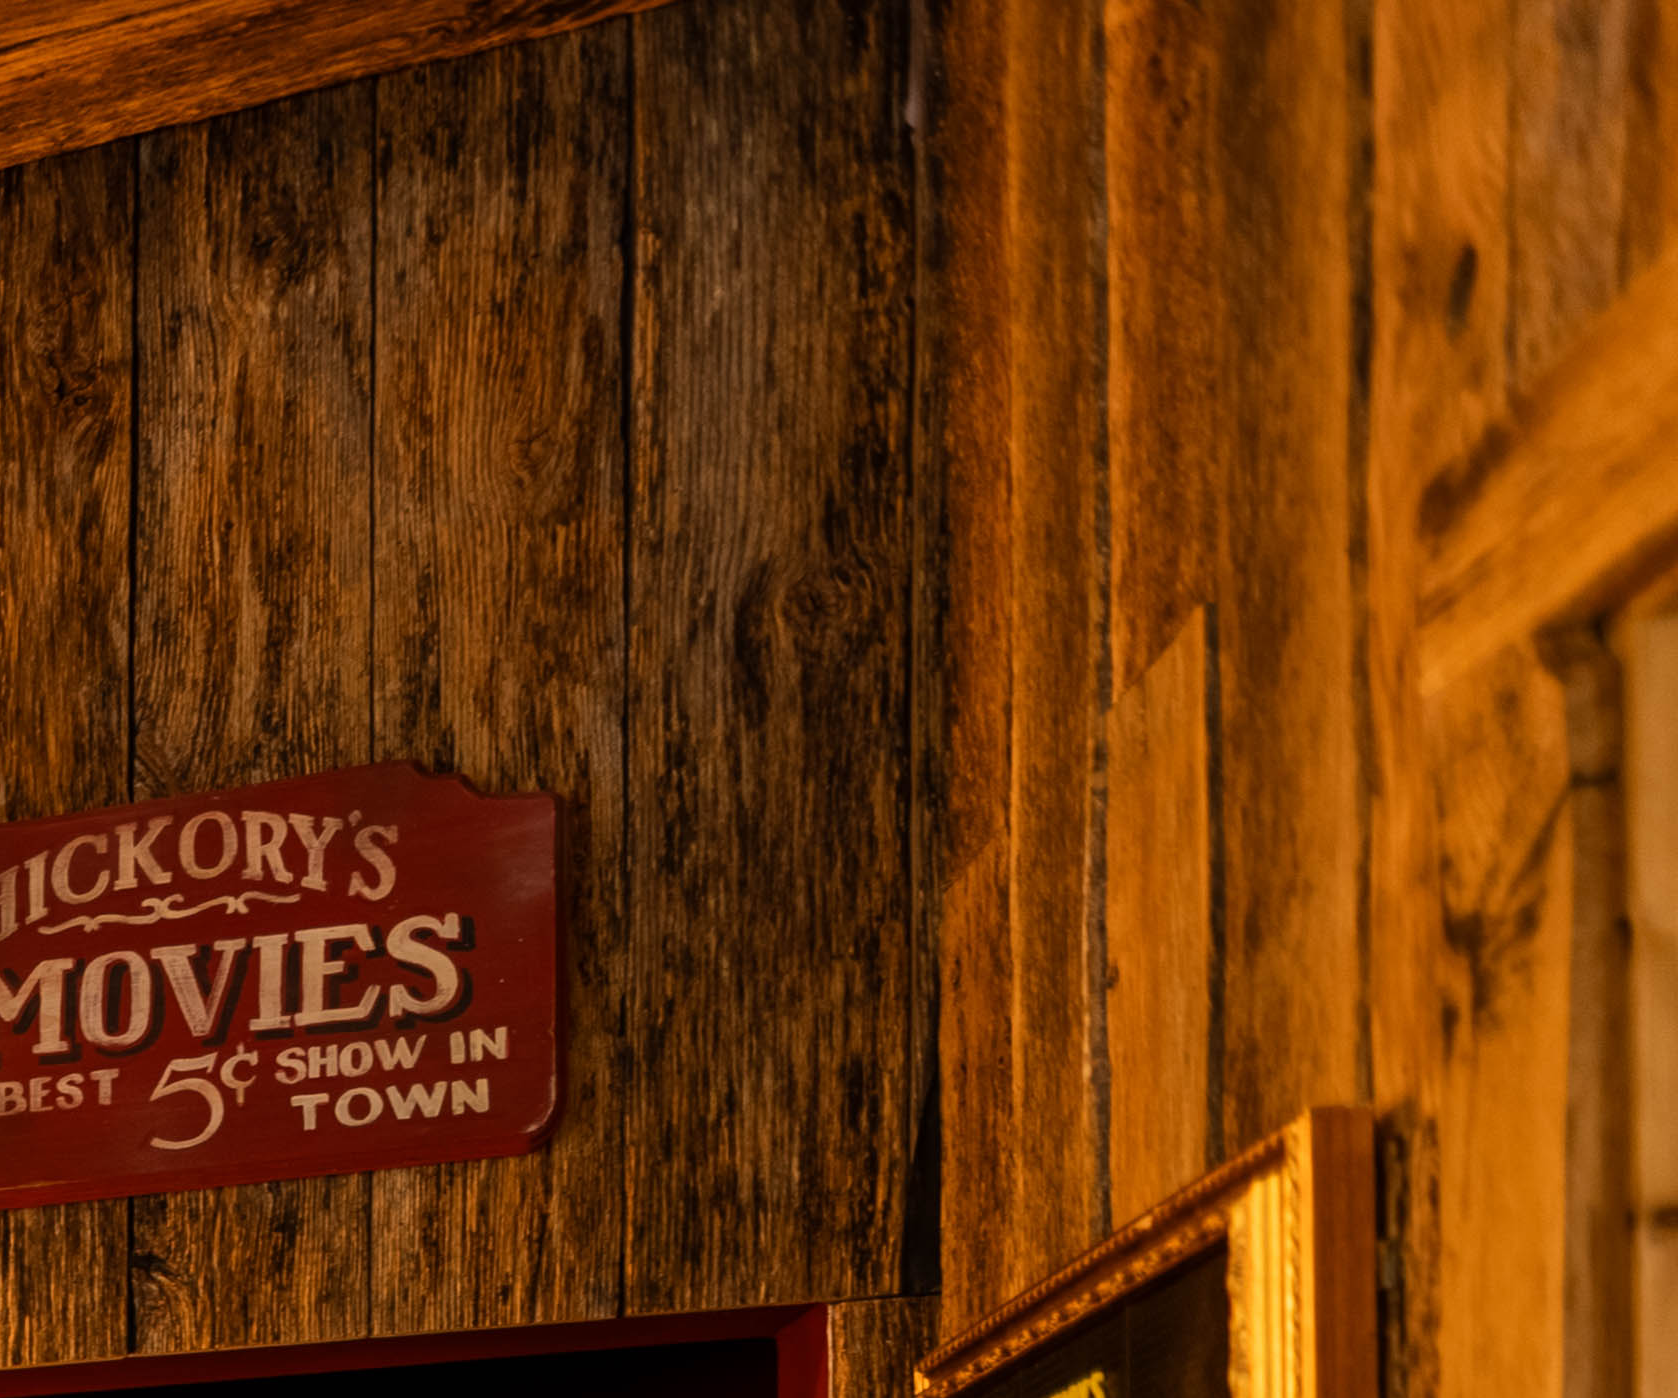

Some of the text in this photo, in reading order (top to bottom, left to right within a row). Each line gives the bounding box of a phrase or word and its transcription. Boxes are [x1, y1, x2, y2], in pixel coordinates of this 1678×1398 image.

[150, 1043, 258, 1150] 5¢
[275, 1034, 427, 1084] SHOW
[449, 1027, 507, 1064] IN
[291, 1078, 489, 1130] TOWN
